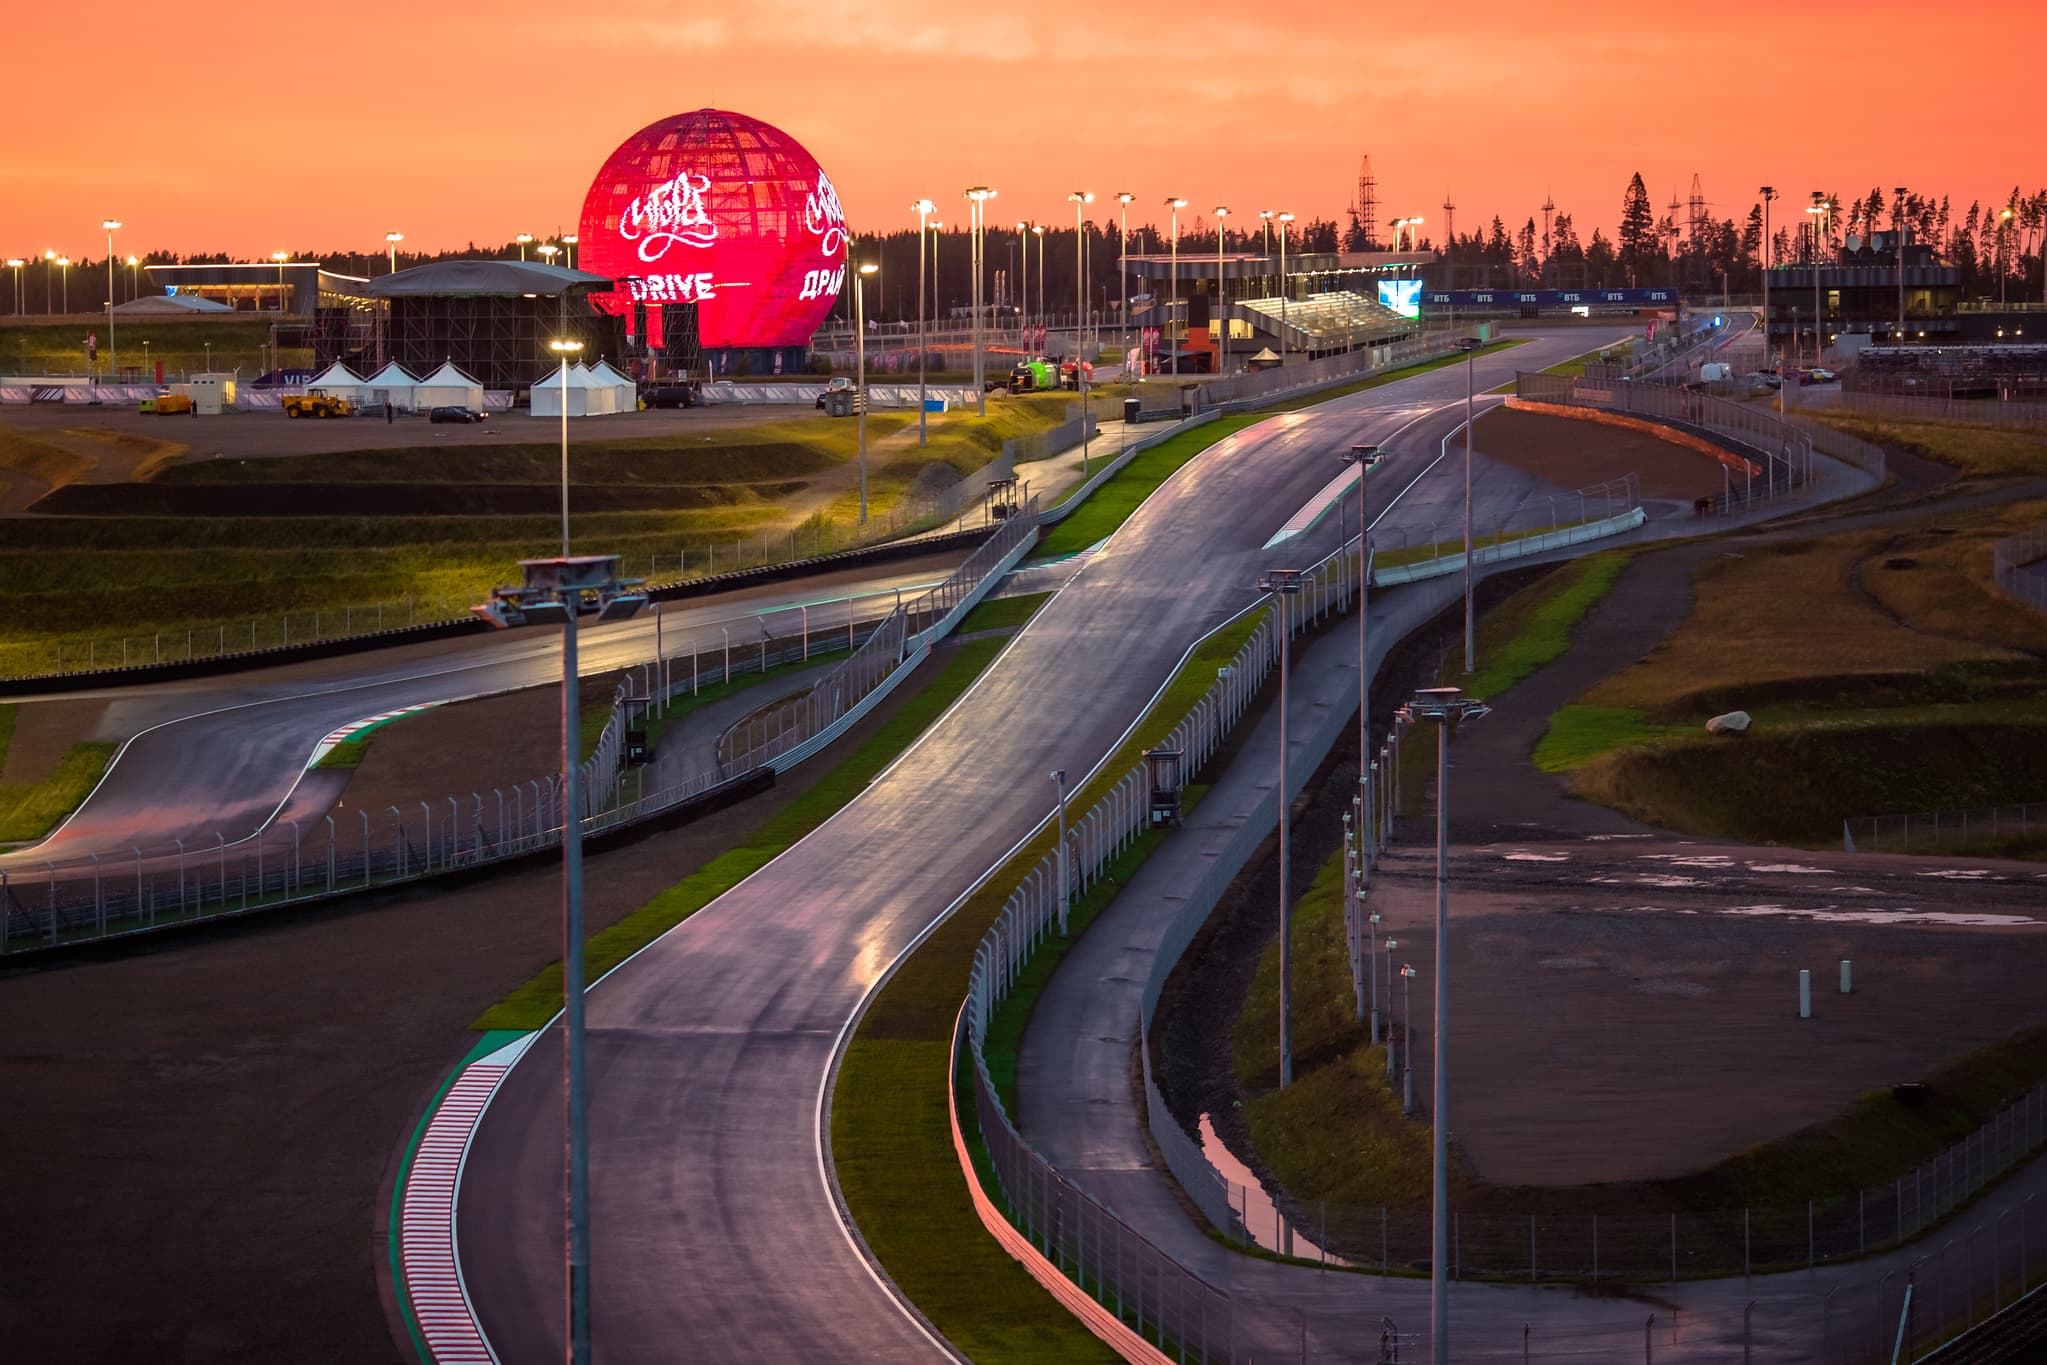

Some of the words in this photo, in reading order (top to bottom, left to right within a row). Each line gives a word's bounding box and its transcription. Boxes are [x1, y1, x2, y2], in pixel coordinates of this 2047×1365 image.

[627, 272, 717, 301] DRIVE
[1433, 294, 1450, 303] ВТБ
[1477, 294, 1493, 303] ВТБ
[1520, 294, 1537, 302] ВТБ
[1564, 293, 1580, 302] ВТБ
[1607, 292, 1624, 301] ВТБ
[1651, 291, 1667, 300] ВТБ
